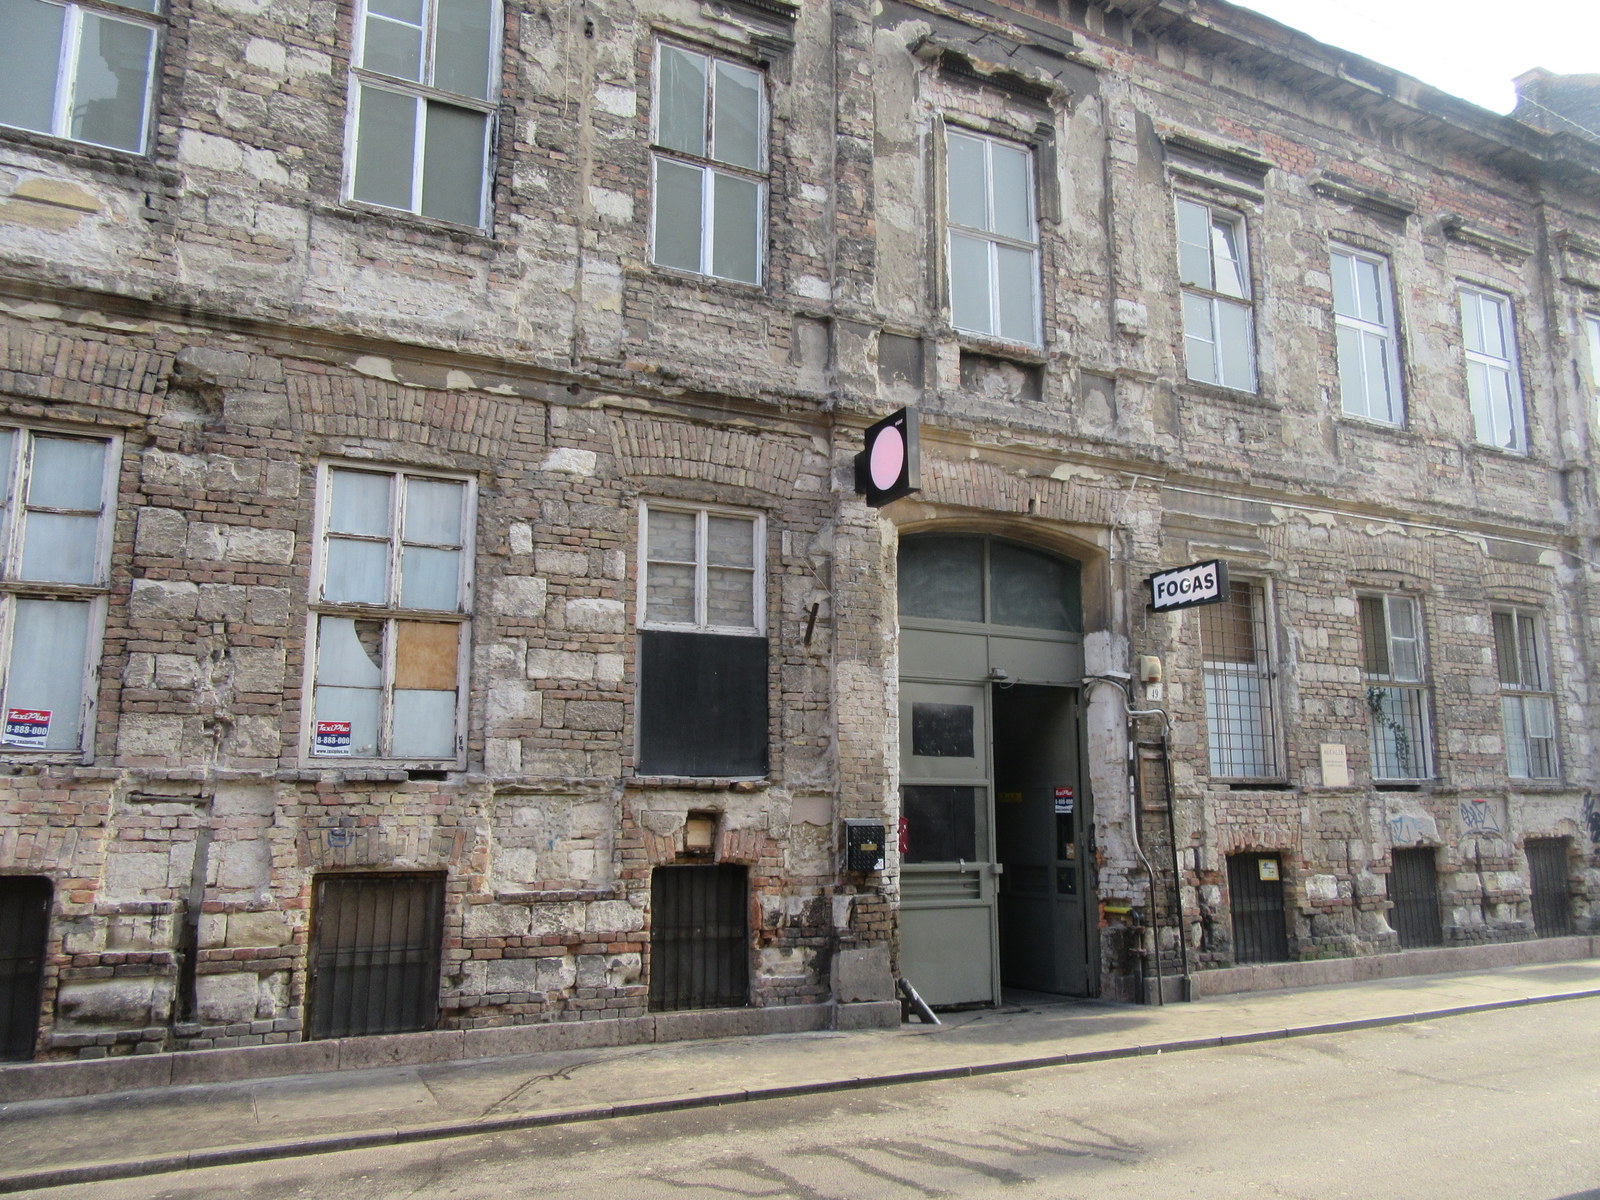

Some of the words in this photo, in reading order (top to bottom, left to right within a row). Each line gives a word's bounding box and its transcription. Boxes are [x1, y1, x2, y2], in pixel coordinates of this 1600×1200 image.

[1157, 573, 1214, 599] FOGAS
[1151, 688, 1159, 699] 49
[6, 724, 47, 735] 8-888-000
[317, 736, 350, 744] 8-888-000
